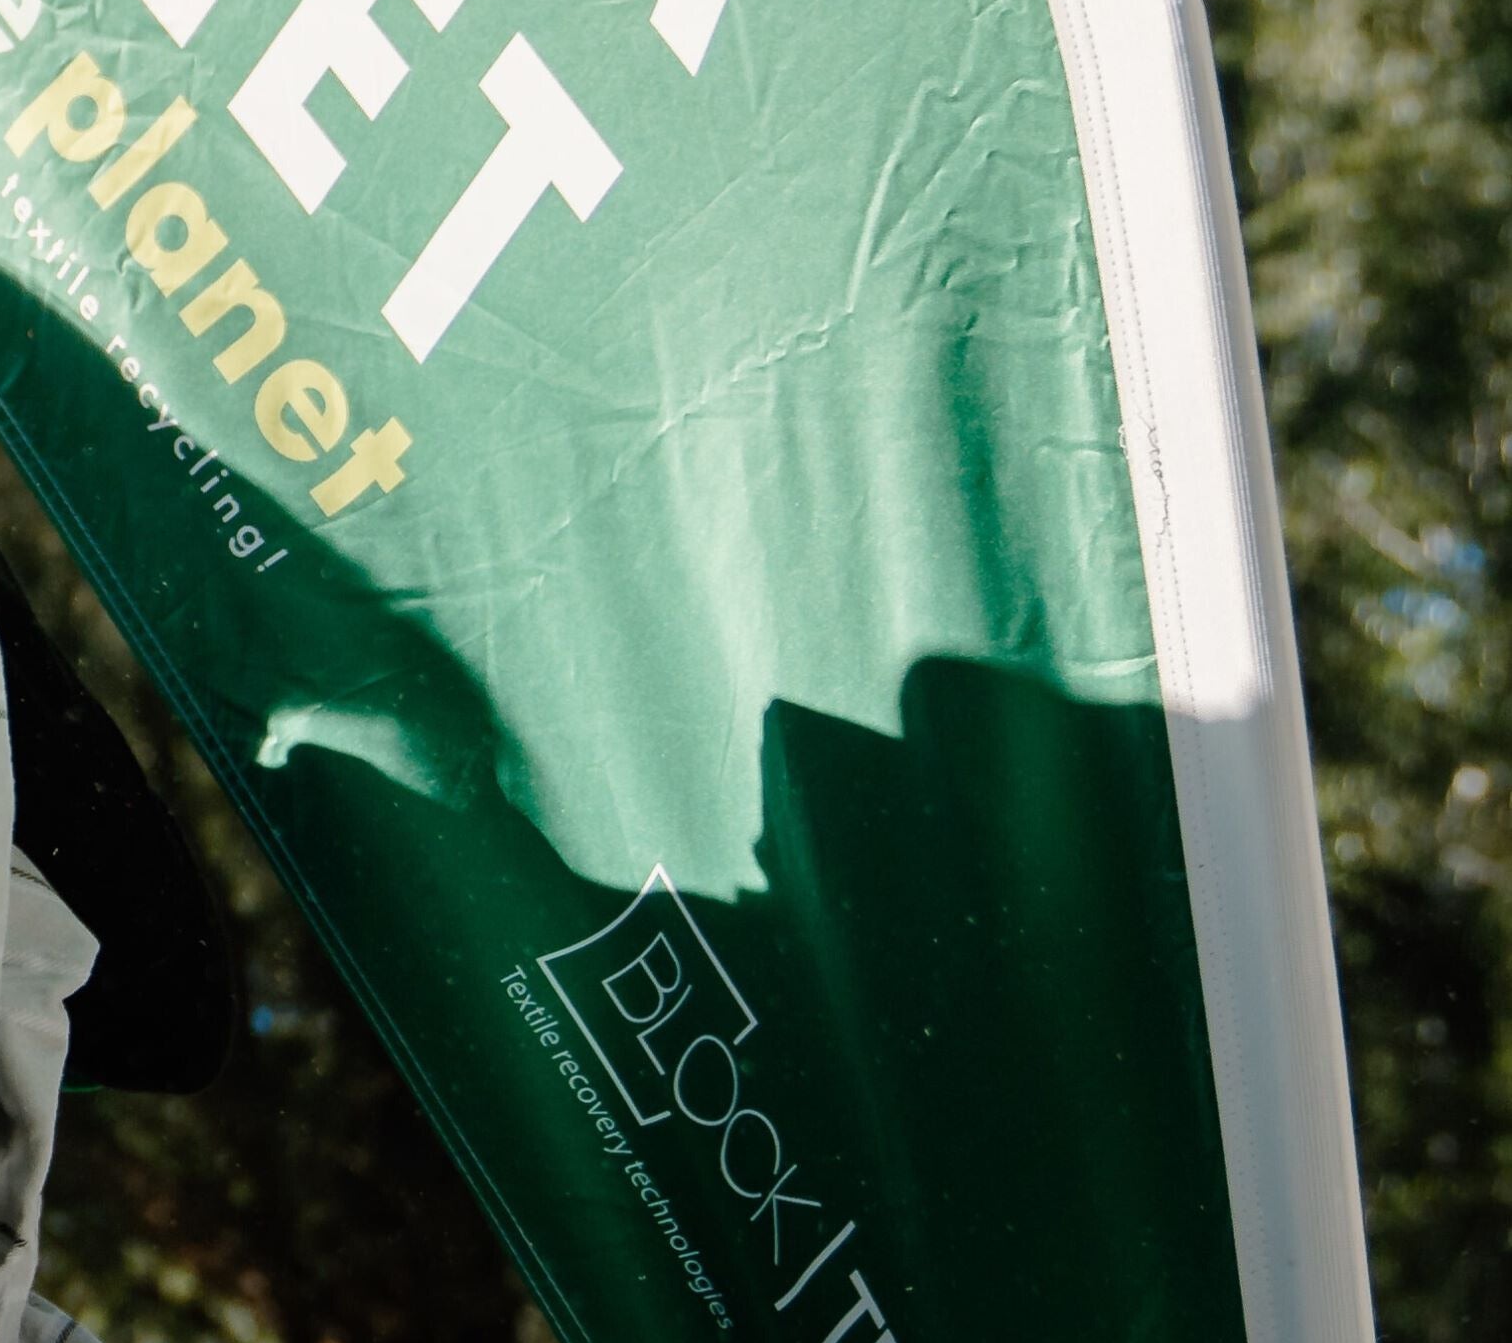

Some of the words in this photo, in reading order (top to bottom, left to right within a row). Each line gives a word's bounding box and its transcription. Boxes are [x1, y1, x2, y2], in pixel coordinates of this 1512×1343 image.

[0, 173, 100, 321] textile
[106, 334, 289, 573] recycling!
[3, 50, 416, 519] planet
[500, 964, 561, 1047] Textile
[551, 1050, 634, 1155] recovery
[624, 1160, 735, 1330] technologies
[601, 932, 822, 1265] BLOCK
